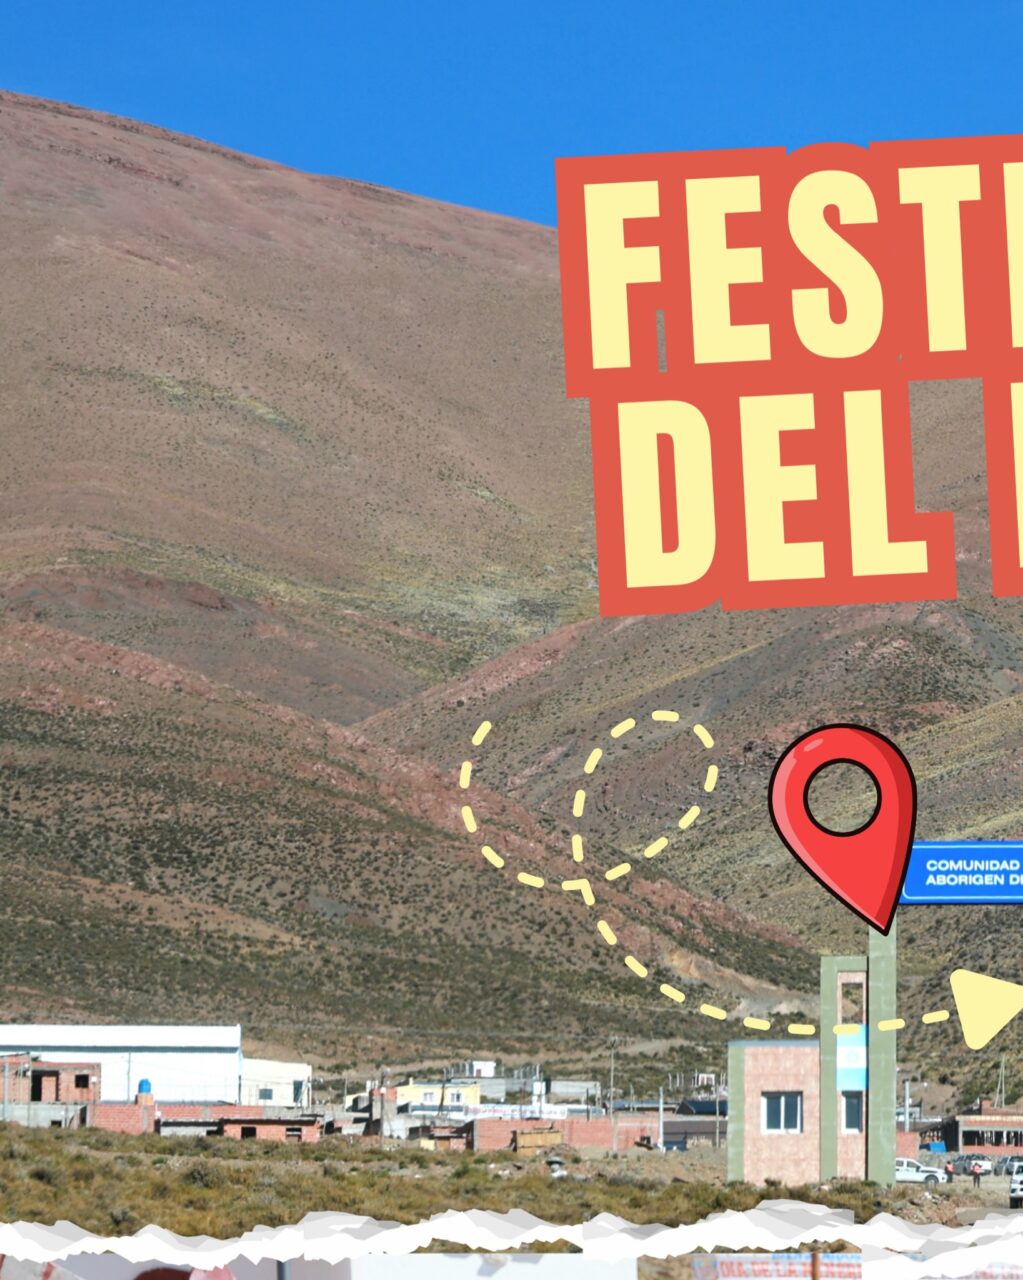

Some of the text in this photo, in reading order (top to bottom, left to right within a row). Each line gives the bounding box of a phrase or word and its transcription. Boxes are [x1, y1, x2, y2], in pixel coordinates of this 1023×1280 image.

[926, 859, 1021, 871] COMUNIDAD
[925, 874, 1005, 886] ABORIGEN
[751, 1261, 772, 1277] DE
